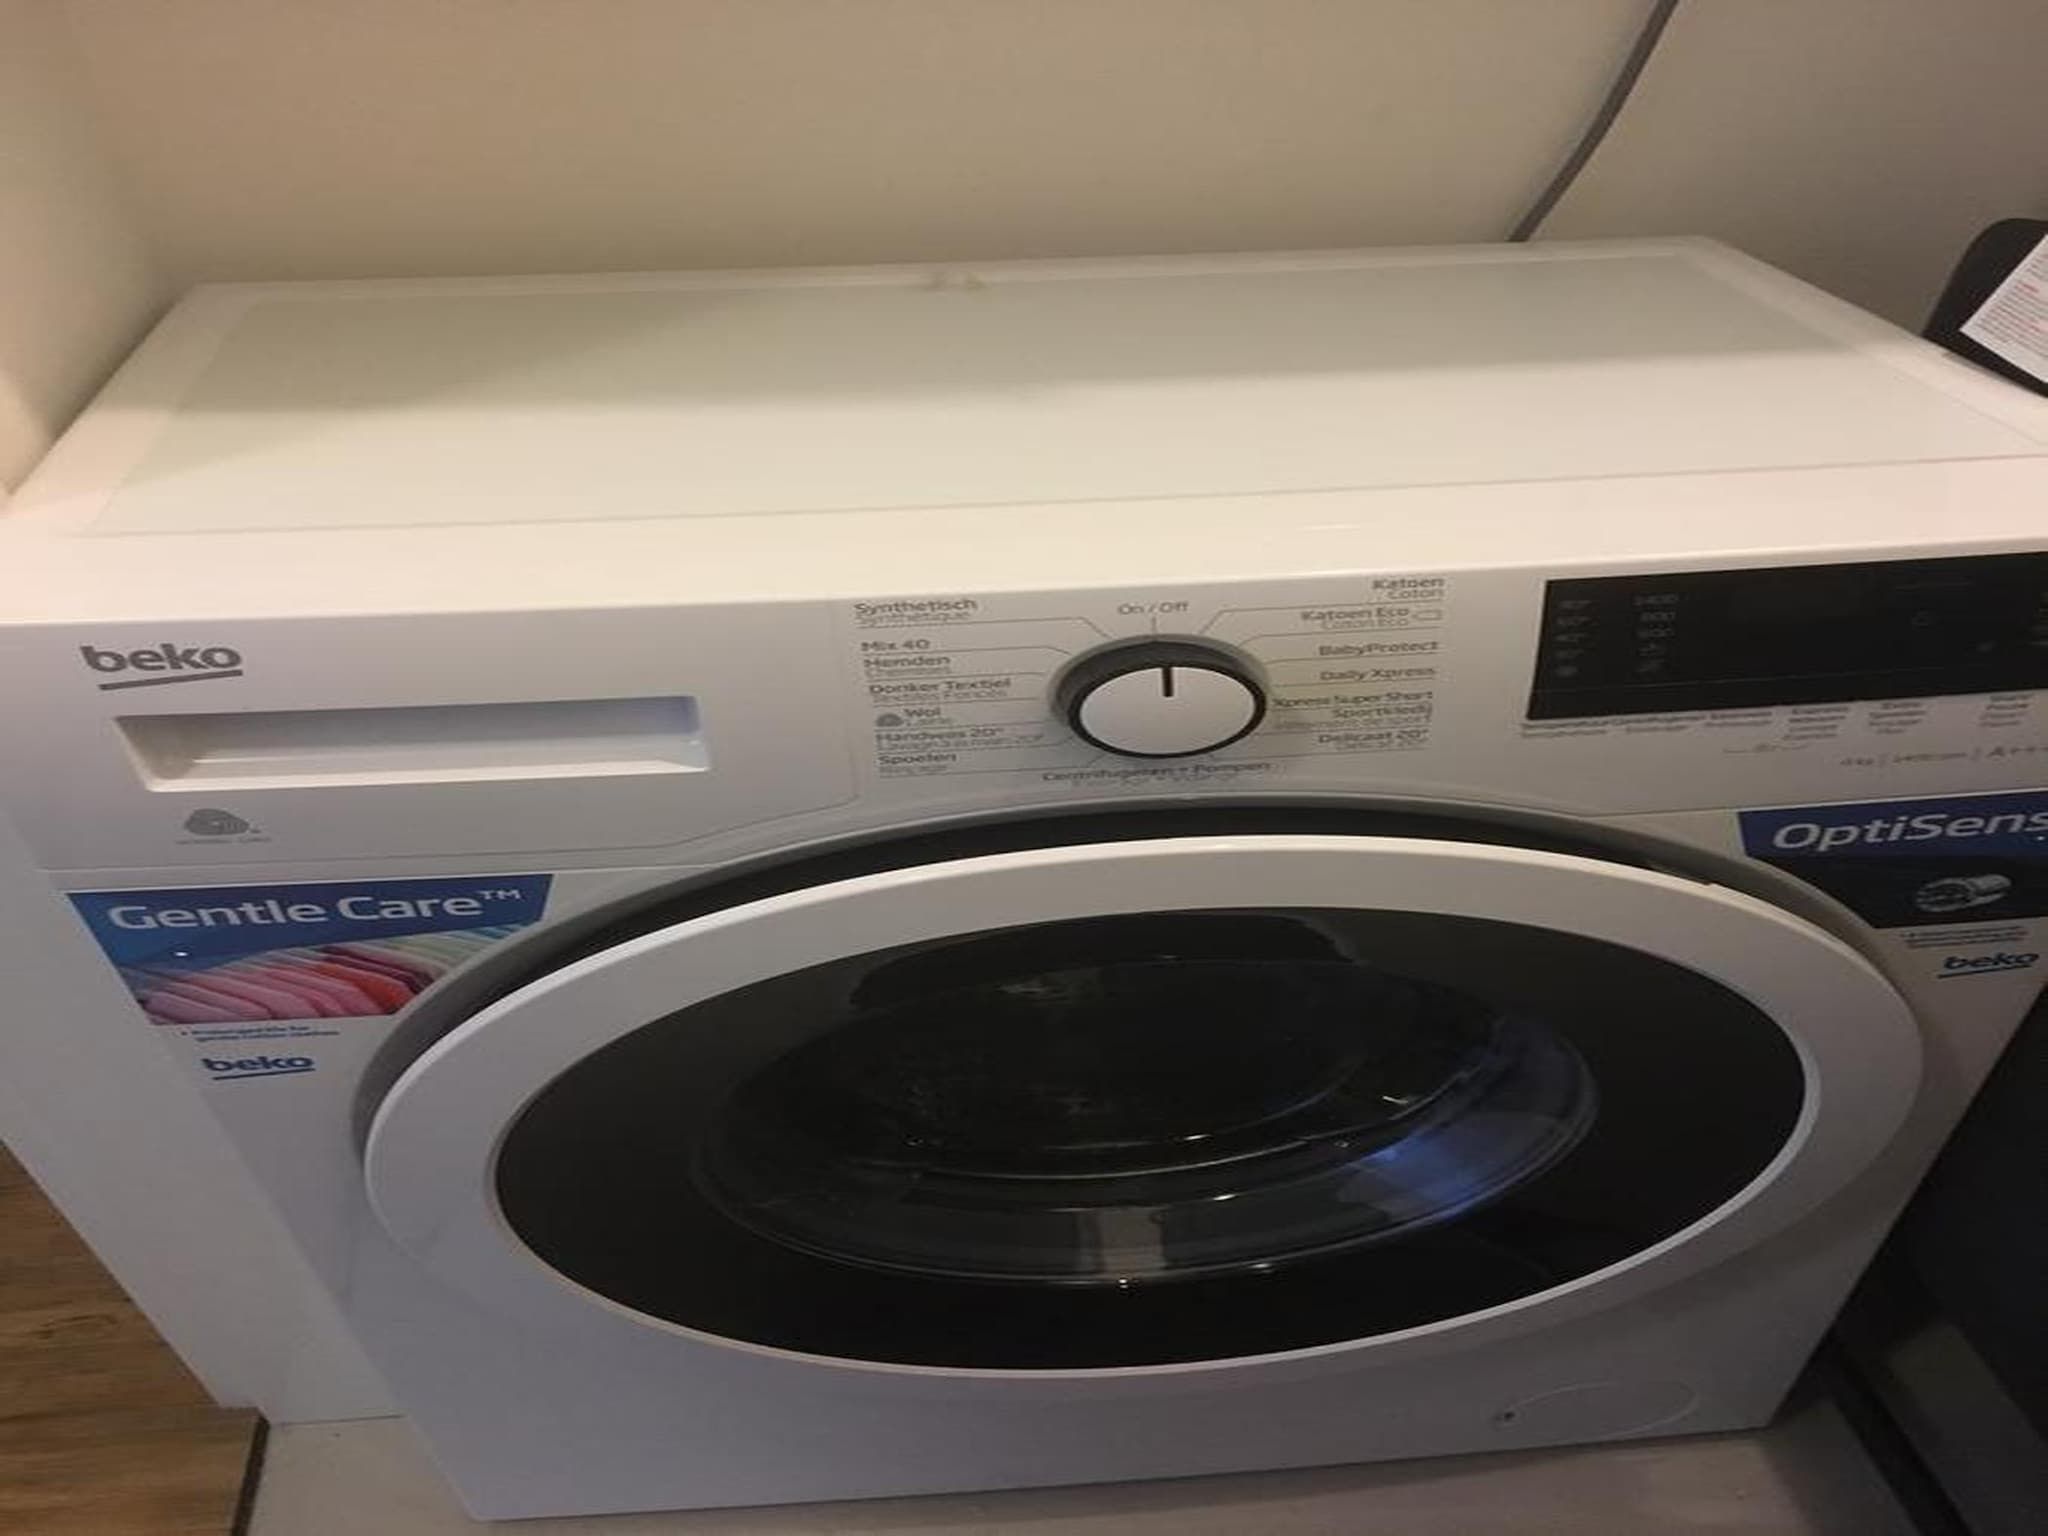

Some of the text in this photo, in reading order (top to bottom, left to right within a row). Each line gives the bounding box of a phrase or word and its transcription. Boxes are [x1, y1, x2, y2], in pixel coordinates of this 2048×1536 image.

[1372, 577, 1445, 590] Katoen
[854, 597, 978, 616] Synthetisch
[1118, 602, 1145, 615] On
[1159, 600, 1189, 613] Off
[1302, 606, 1410, 621] Katoen Eco
[903, 638, 930, 650] 40
[1319, 640, 1440, 656] BabyProtect
[79, 643, 242, 672] beko
[110, 898, 330, 931] Gentle
[1943, 951, 2040, 970] beko
[202, 1053, 315, 1074] beko
